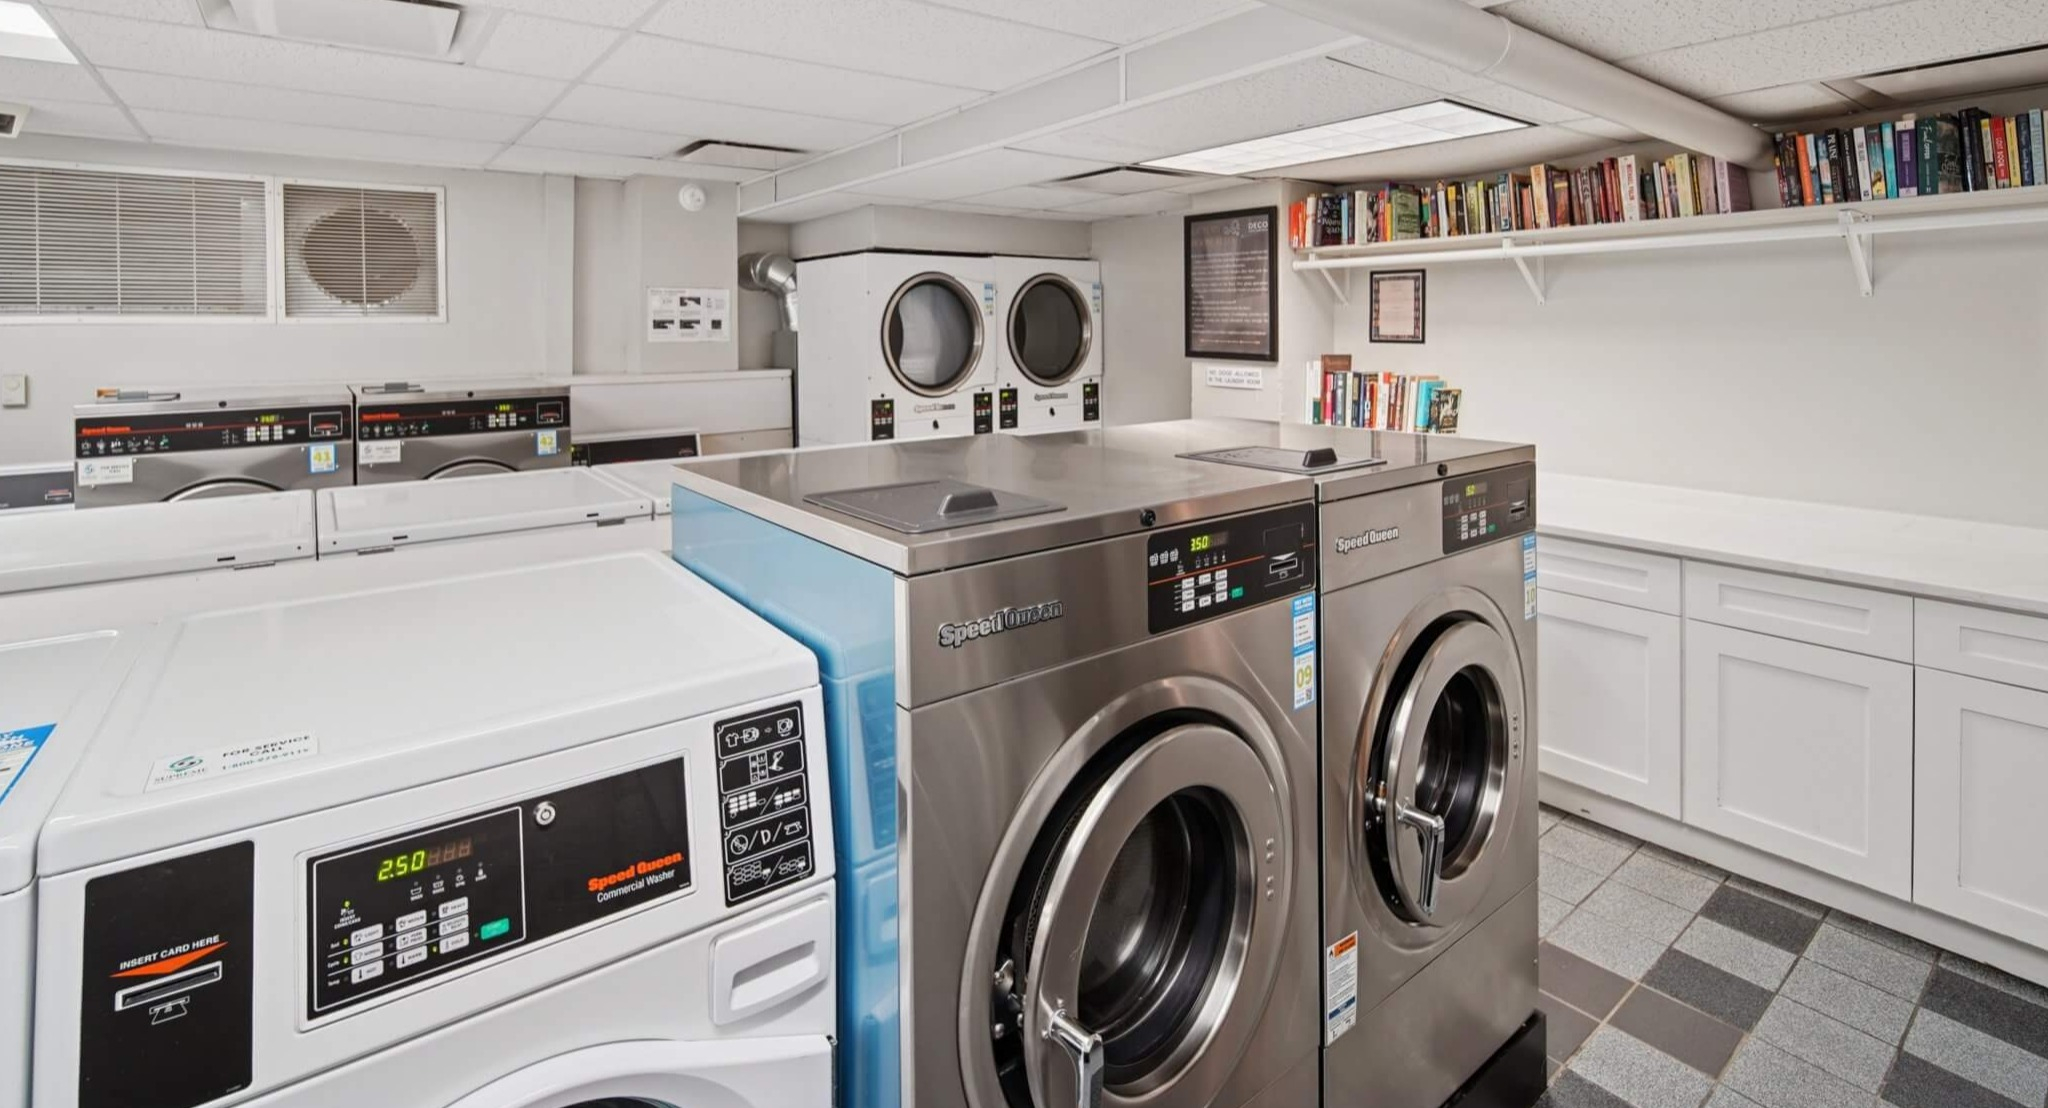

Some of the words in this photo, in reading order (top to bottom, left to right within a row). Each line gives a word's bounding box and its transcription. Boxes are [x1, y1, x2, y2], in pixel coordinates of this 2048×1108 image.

[1248, 220, 1269, 229] DECO
[1335, 531, 1369, 555] Speed
[1369, 526, 1400, 545] Queen
[938, 611, 1004, 649] Speed
[1004, 600, 1064, 630] Queen
[1296, 666, 1313, 688] 09
[222, 748, 250, 758] FOR
[255, 735, 310, 751] SERVICE
[249, 746, 284, 757] CALL
[154, 767, 206, 784] SUPREME
[378, 849, 426, 882] 2.50
[588, 864, 636, 892] Speed
[636, 852, 683, 875] Queen
[596, 879, 646, 904] Commercial
[646, 869, 676, 887] Washer
[119, 952, 158, 970] INSERT
[160, 943, 190, 959] CARD
[191, 934, 221, 950] HERE
